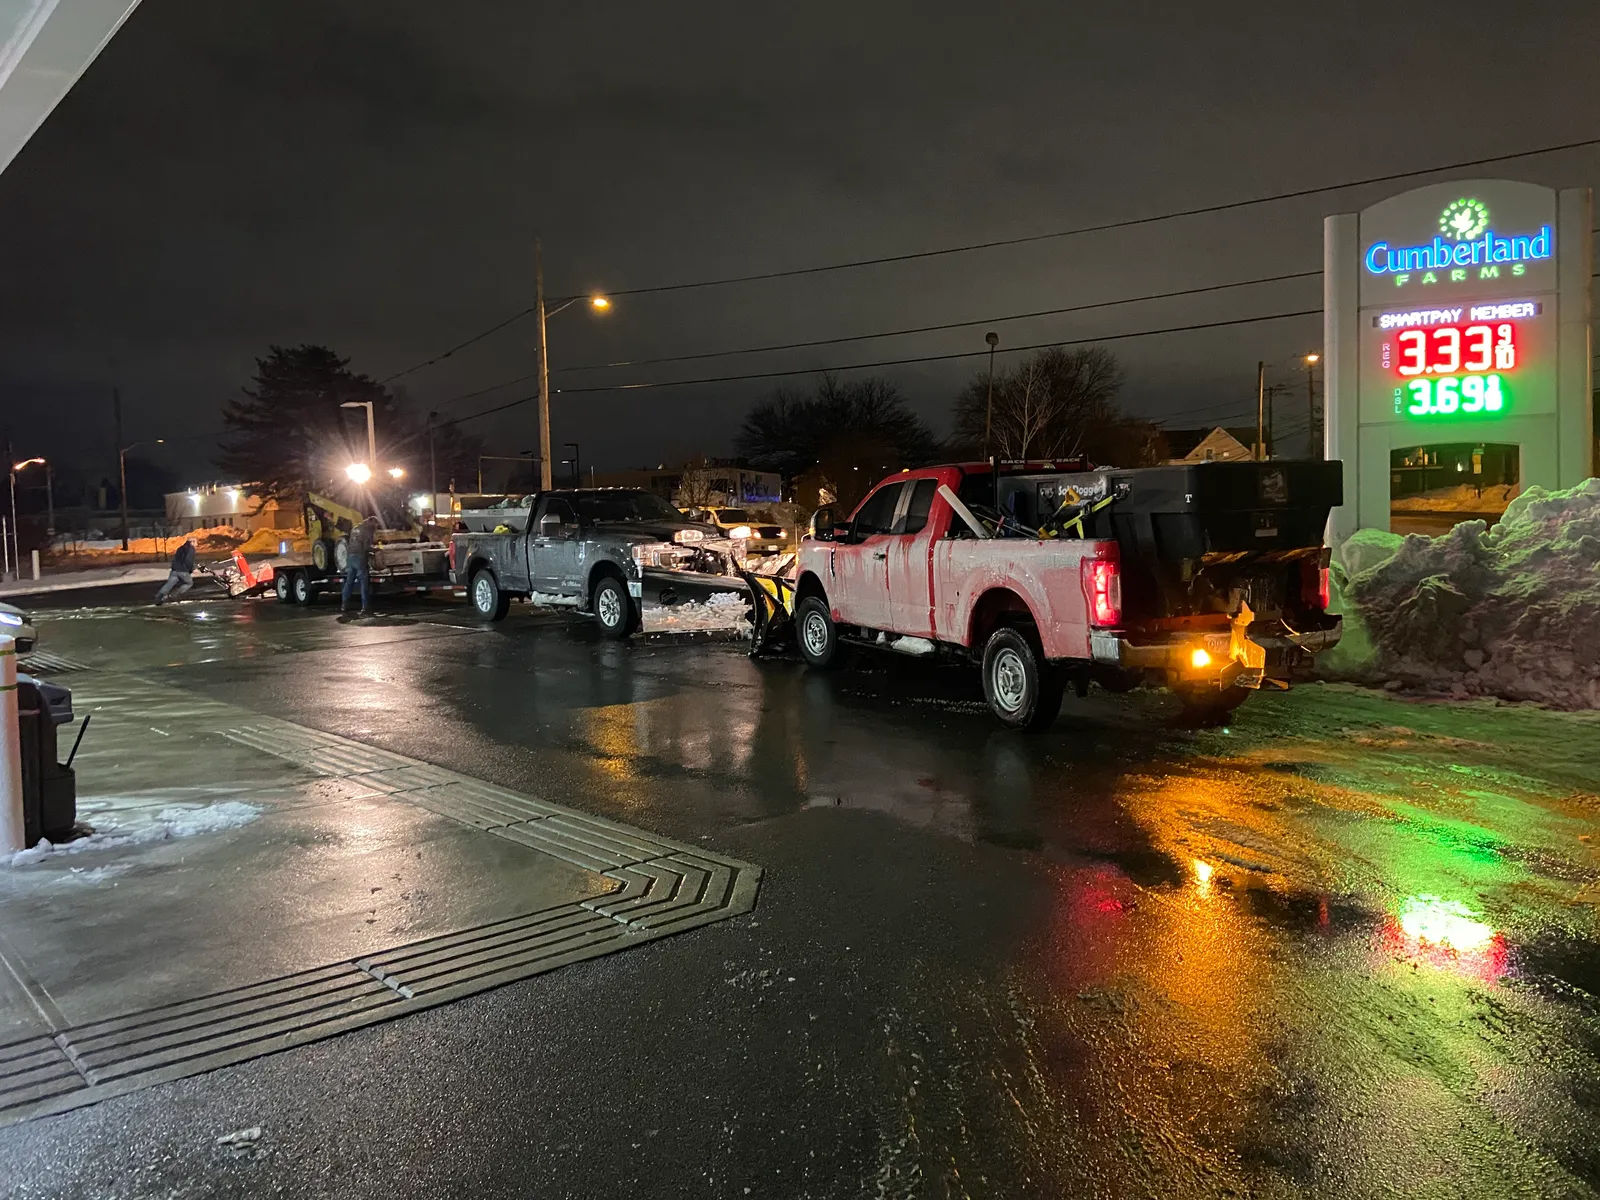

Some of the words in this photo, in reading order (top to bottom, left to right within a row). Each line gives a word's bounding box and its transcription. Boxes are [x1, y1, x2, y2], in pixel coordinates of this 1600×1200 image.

[1365, 226, 1551, 274] Cumberland
[1396, 264, 1525, 286] FARMS
[1379, 308, 1463, 329] SMARTPAY
[1470, 302, 1534, 321] MEMBER
[1382, 343, 1391, 369] REG
[1394, 387, 1402, 414] DSL
